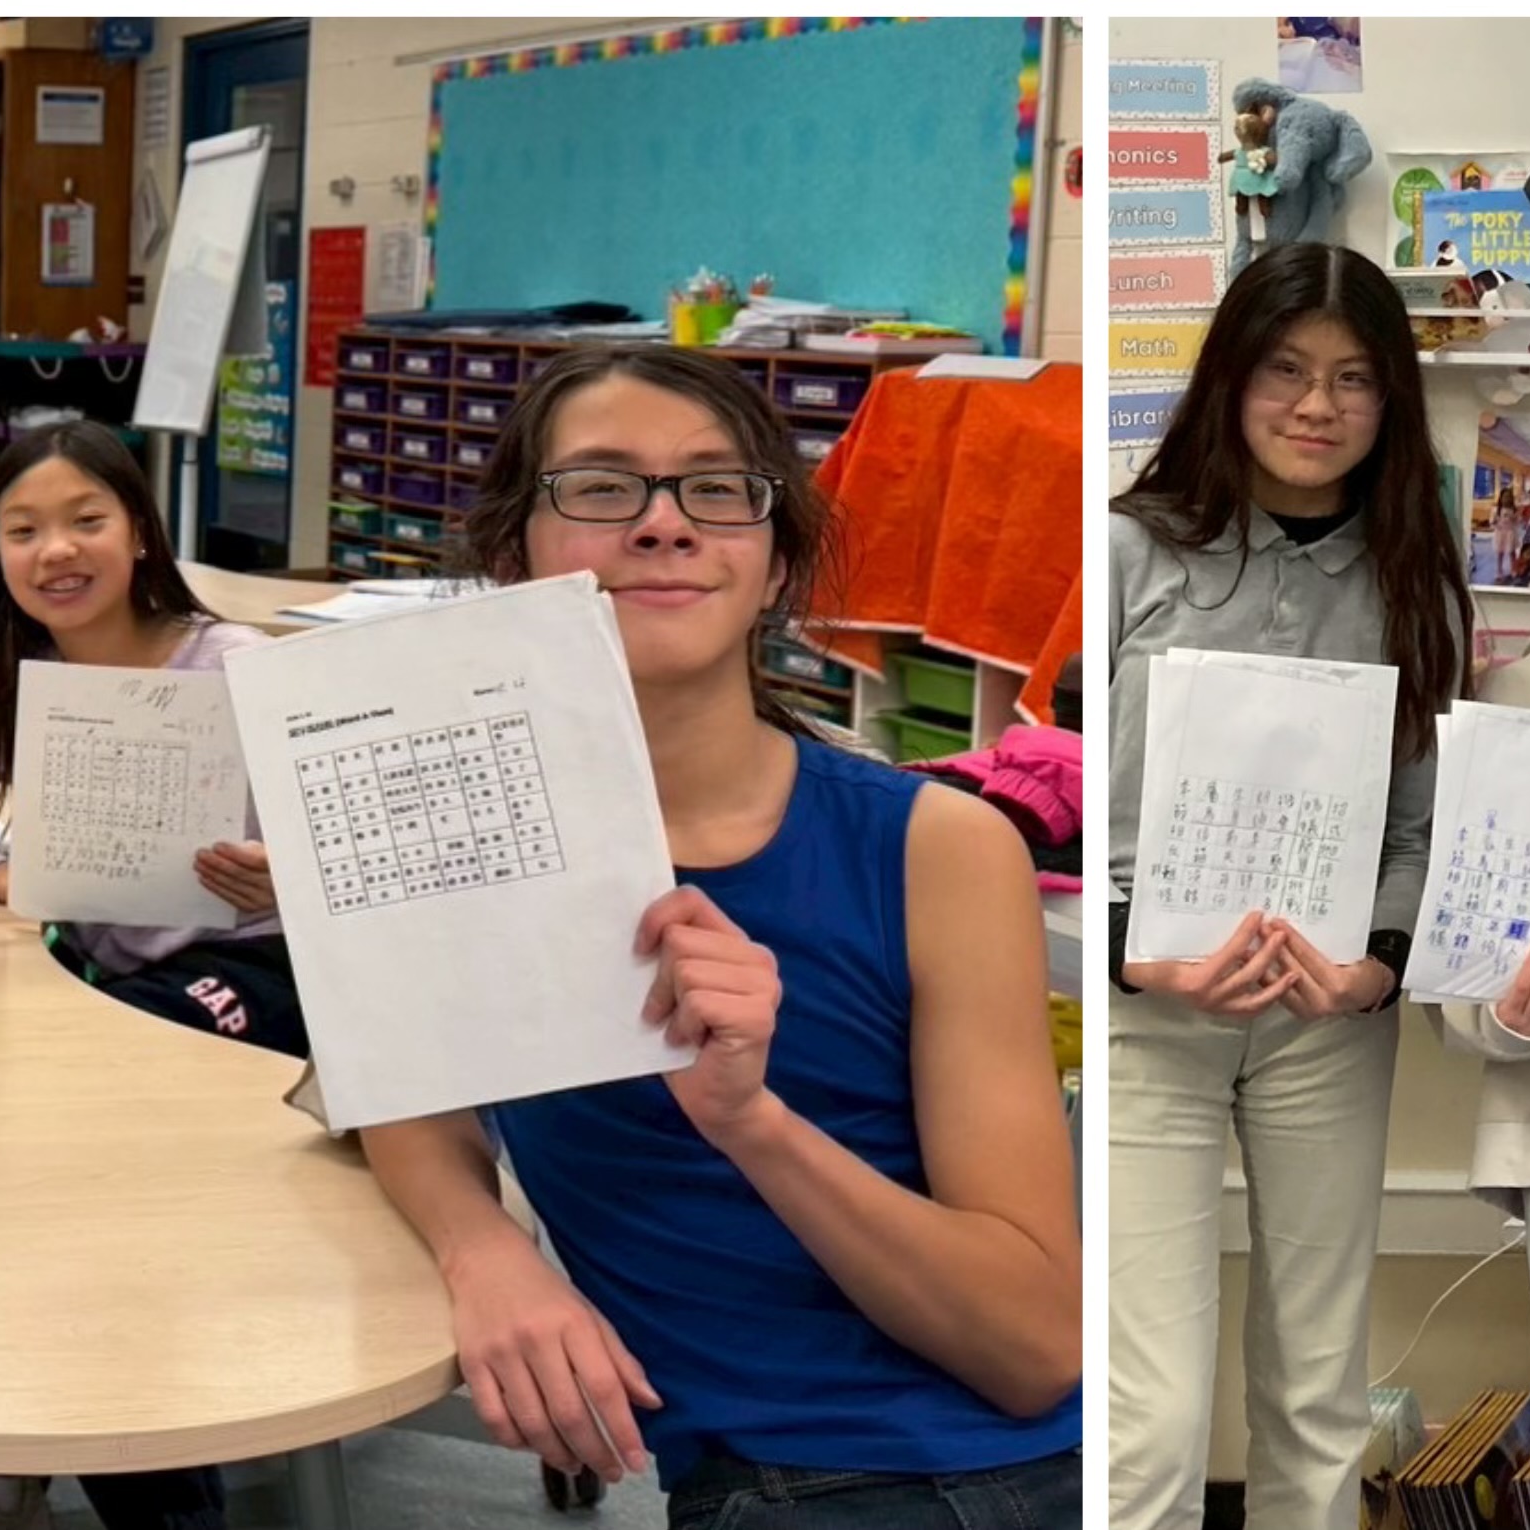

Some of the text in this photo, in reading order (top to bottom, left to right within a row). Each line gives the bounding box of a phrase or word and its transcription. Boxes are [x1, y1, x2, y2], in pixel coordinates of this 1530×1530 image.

[1129, 77, 1198, 97] Meeting
[1446, 212, 1523, 228] The POKY
[1122, 338, 1176, 356] Math
[185, 975, 249, 1034] GAP
